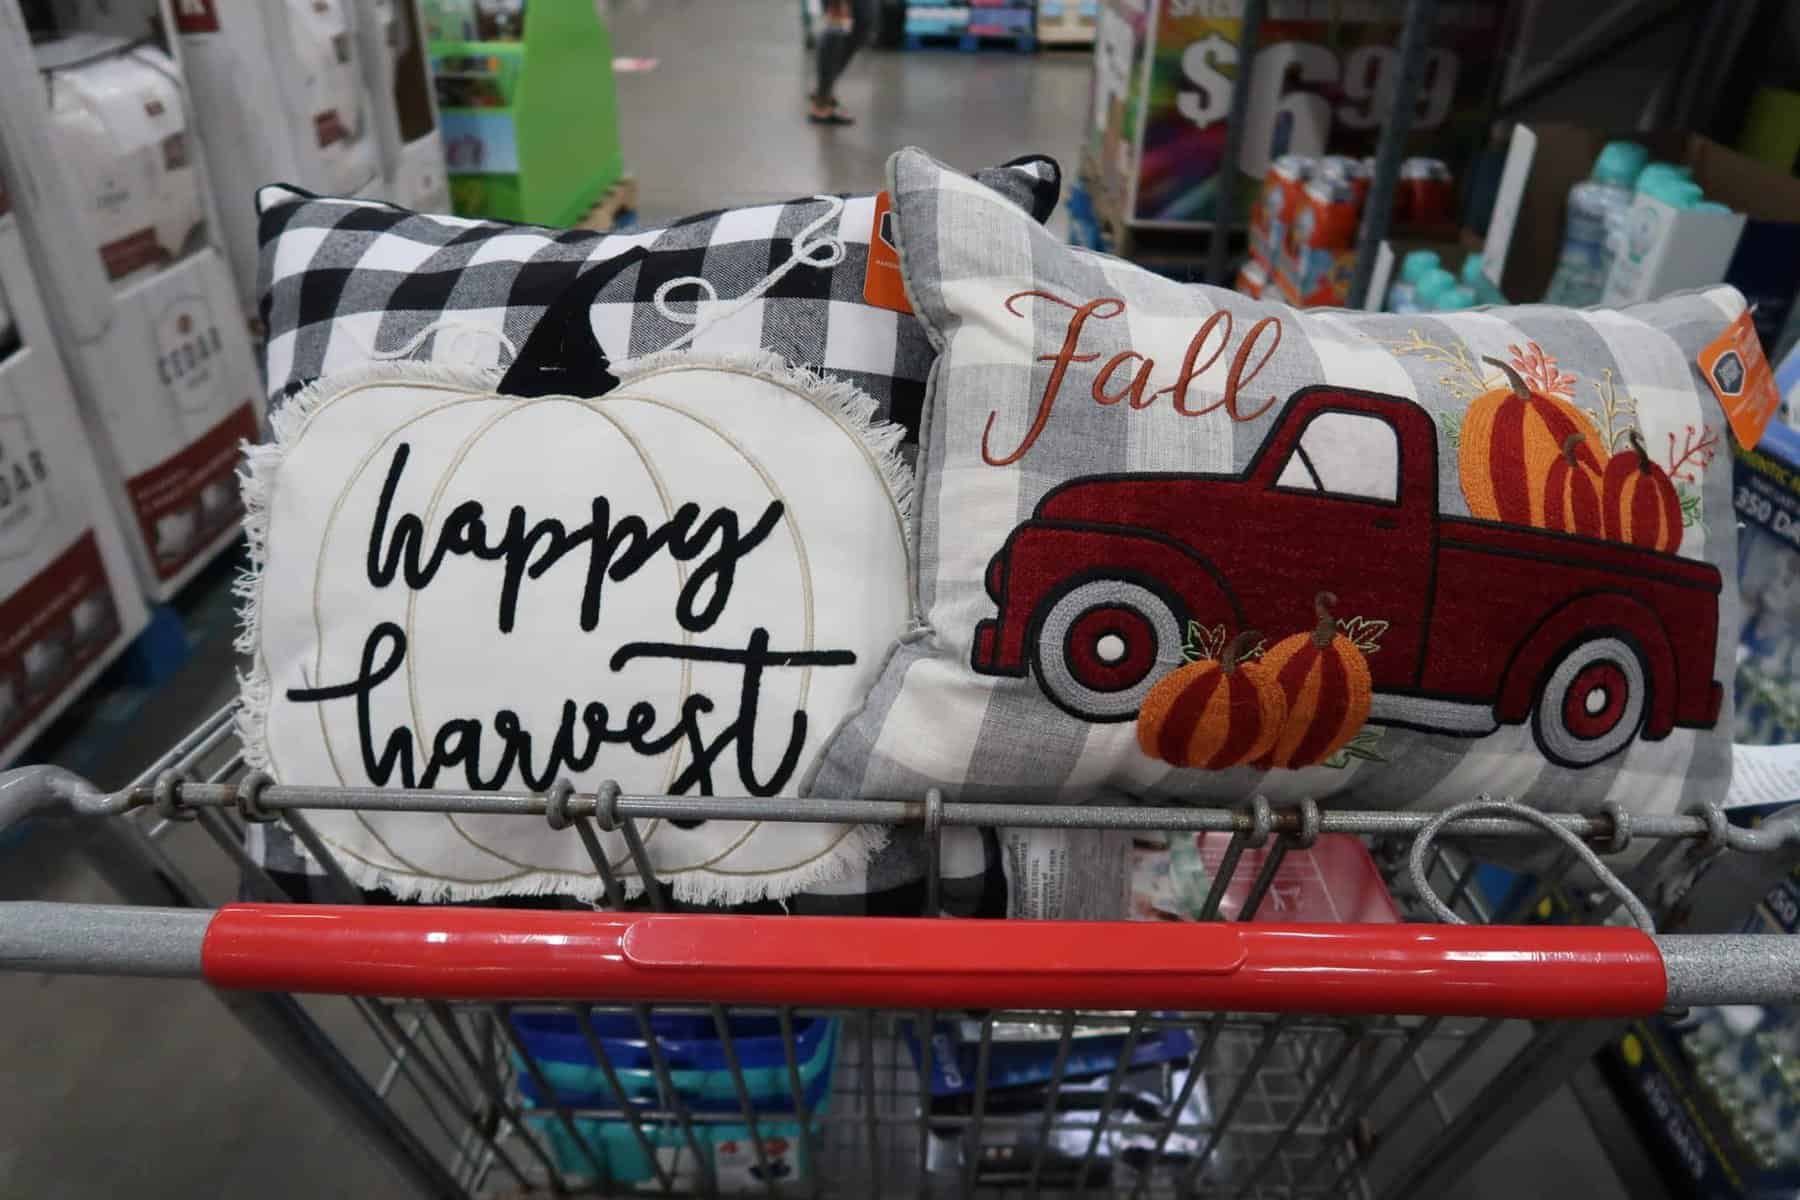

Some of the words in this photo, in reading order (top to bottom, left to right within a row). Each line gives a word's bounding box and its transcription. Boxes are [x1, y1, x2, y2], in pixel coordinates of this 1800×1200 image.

[981, 290, 1283, 467] Fall
[366, 443, 785, 632] happy
[286, 621, 857, 829] harvest
